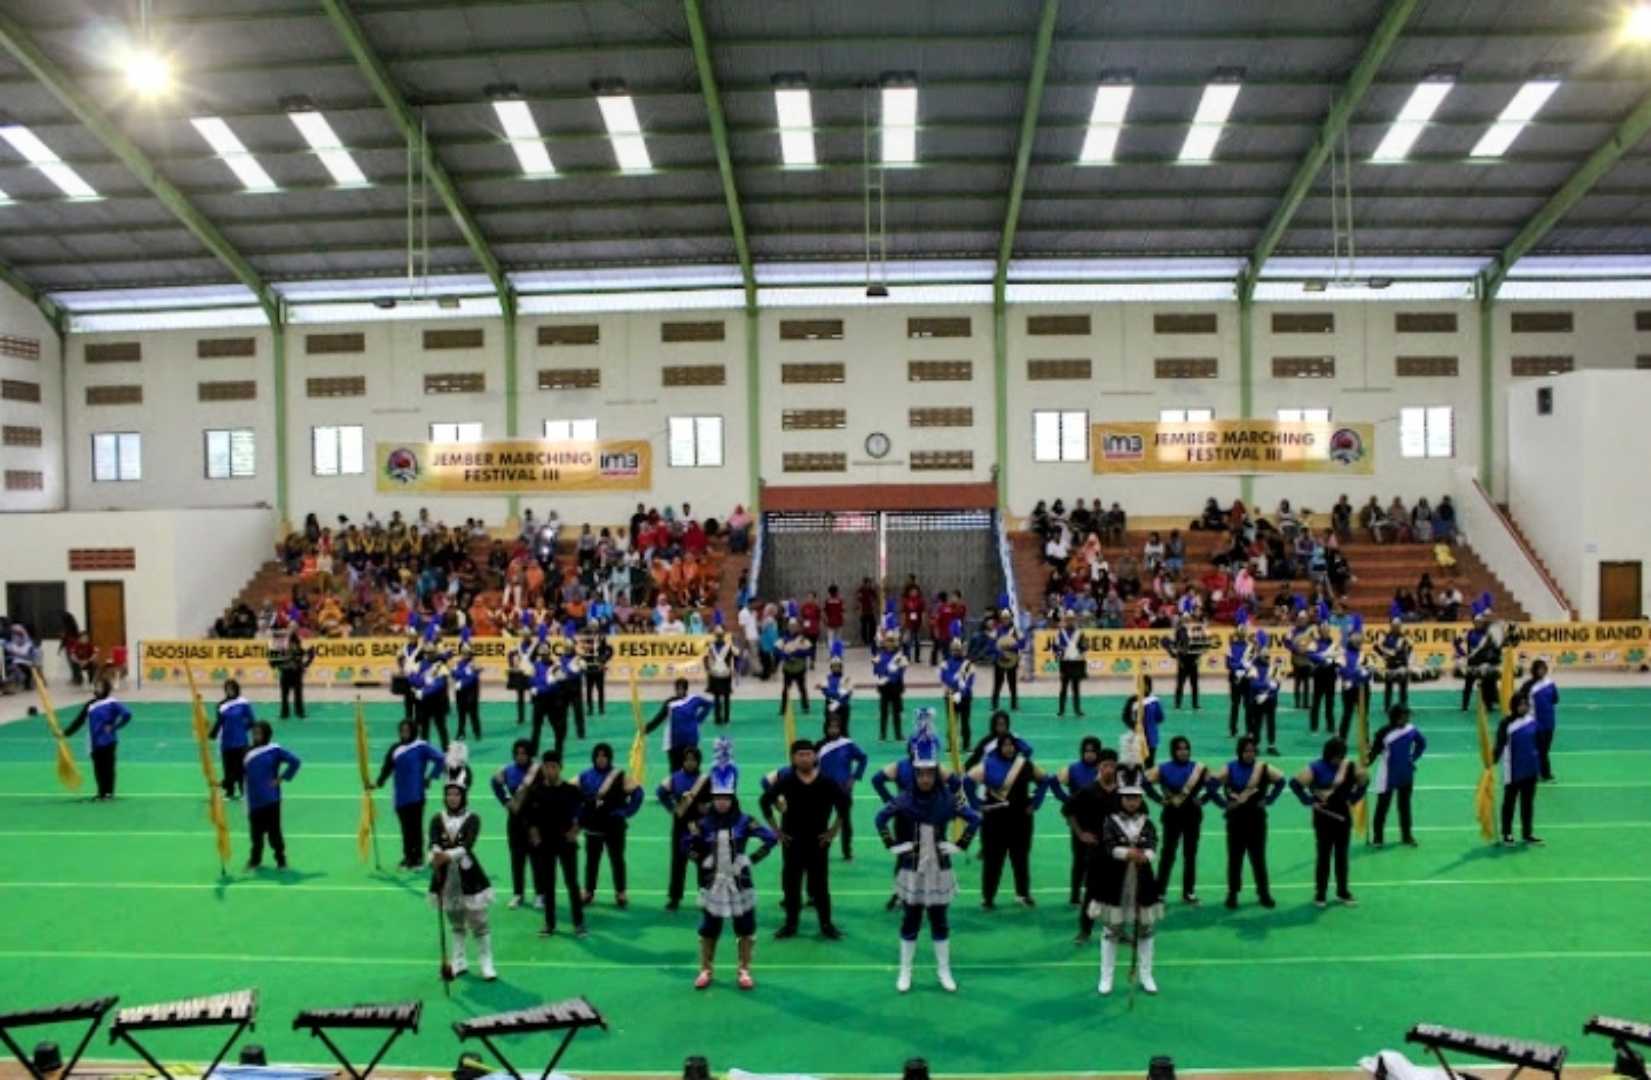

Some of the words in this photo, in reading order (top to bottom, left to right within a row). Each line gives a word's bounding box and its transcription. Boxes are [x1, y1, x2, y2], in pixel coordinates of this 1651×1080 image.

[1155, 432, 1217, 446] JEMBER
[1223, 430, 1315, 445] MARCHING
[433, 452, 494, 466] JEMBER
[499, 451, 592, 466] MARCHING
[1187, 448, 1260, 461] FESTIVAL
[1265, 448, 1283, 461] III
[464, 468, 537, 482] FESTIVAL
[542, 469, 560, 481] III
[1517, 627, 1590, 642] ARCHING
[1596, 625, 1643, 640] BAND
[146, 644, 214, 659] ASOSIASI
[218, 643, 273, 659] PELATI
[619, 641, 699, 657] FESTIVAL
